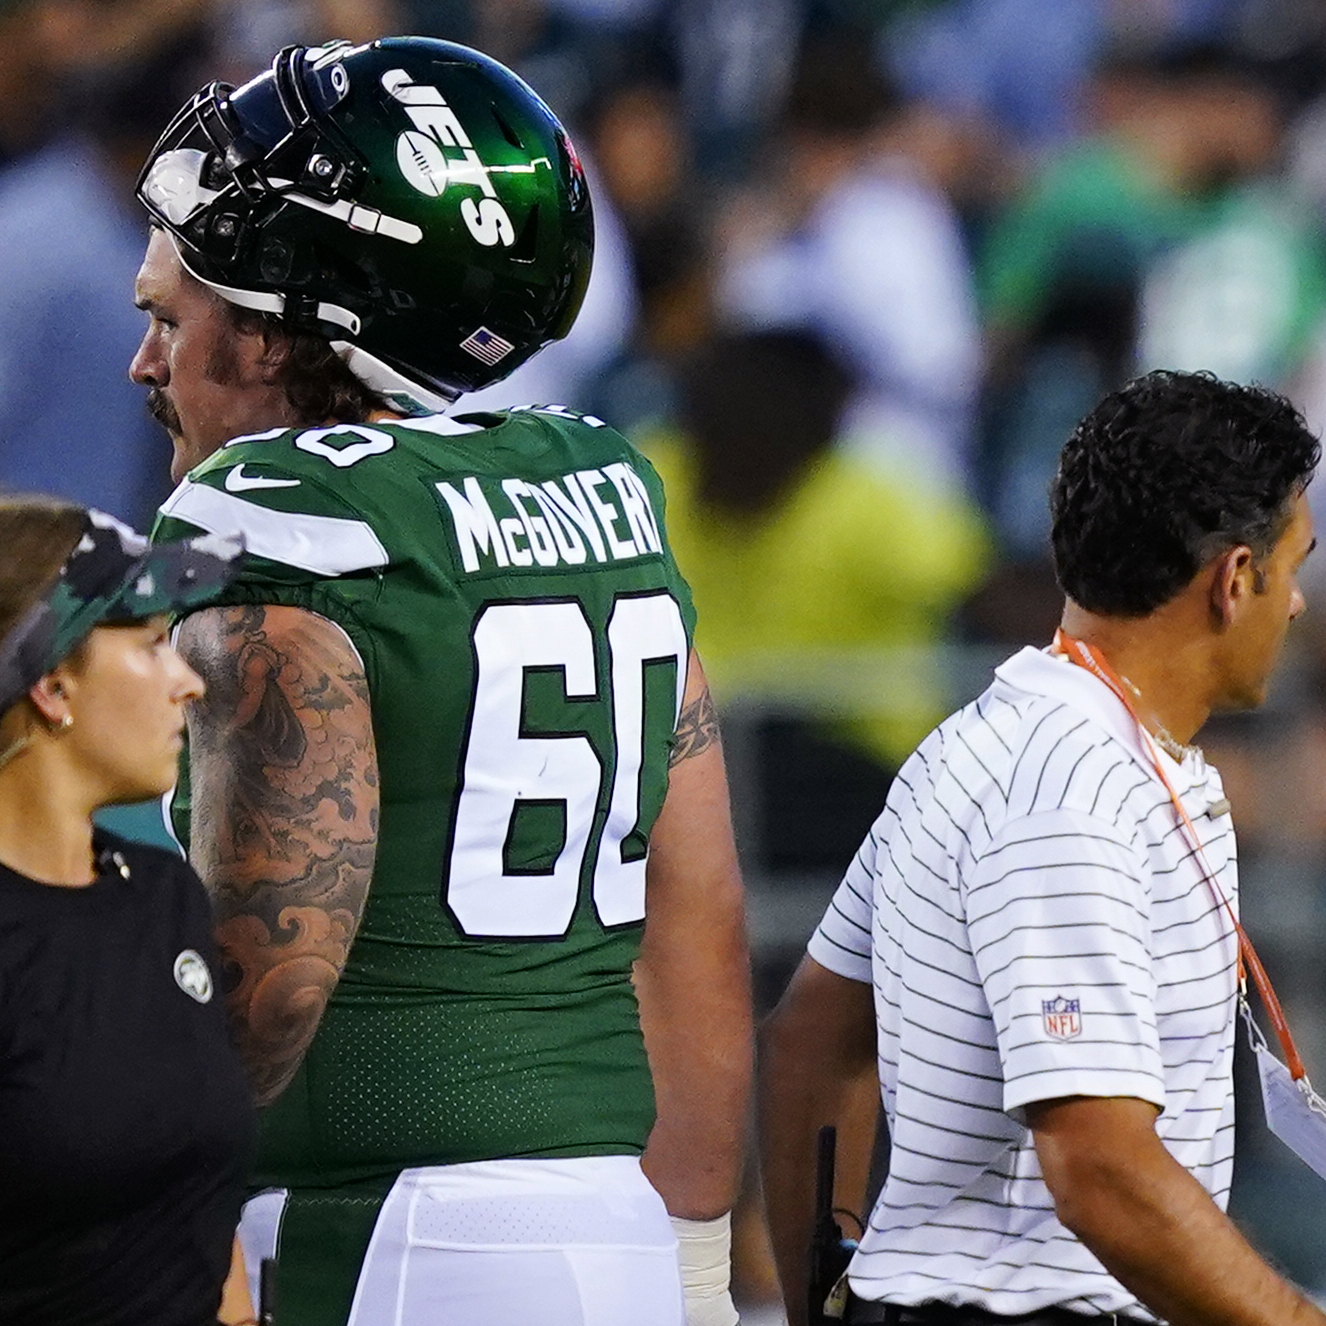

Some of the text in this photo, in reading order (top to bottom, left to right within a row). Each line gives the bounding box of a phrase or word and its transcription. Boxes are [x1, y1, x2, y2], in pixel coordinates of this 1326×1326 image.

[380, 68, 516, 247] JETS
[445, 591, 693, 942] 60
[1047, 1014, 1079, 1036] NFL
